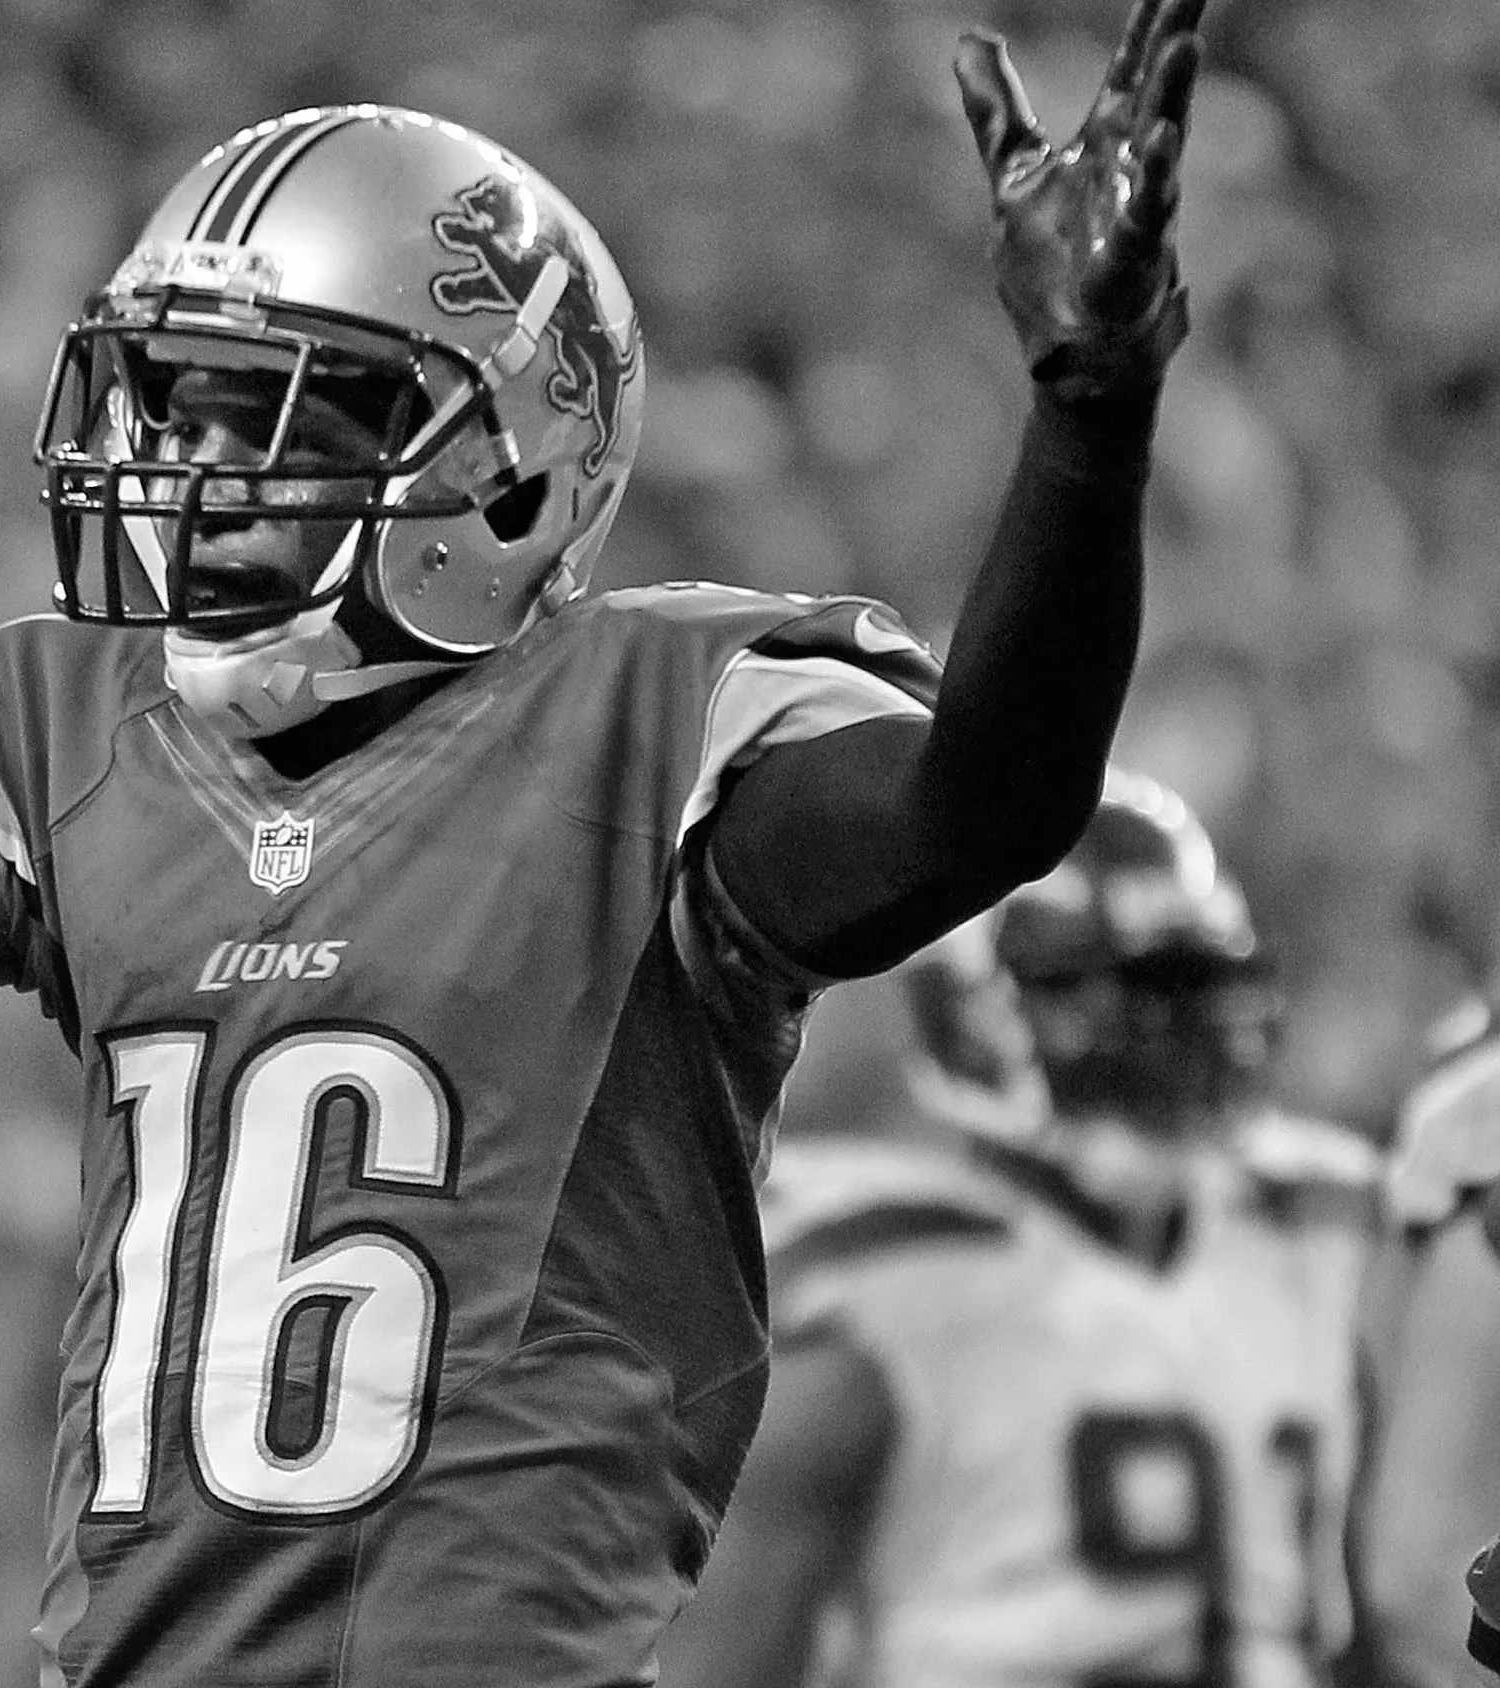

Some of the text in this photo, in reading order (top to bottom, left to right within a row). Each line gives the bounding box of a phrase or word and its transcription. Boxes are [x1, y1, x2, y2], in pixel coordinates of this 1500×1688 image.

[260, 849, 305, 879] NFL
[193, 940, 350, 993] LIONS
[83, 1020, 462, 1524] 16
[1067, 1409, 1322, 1688] 91
